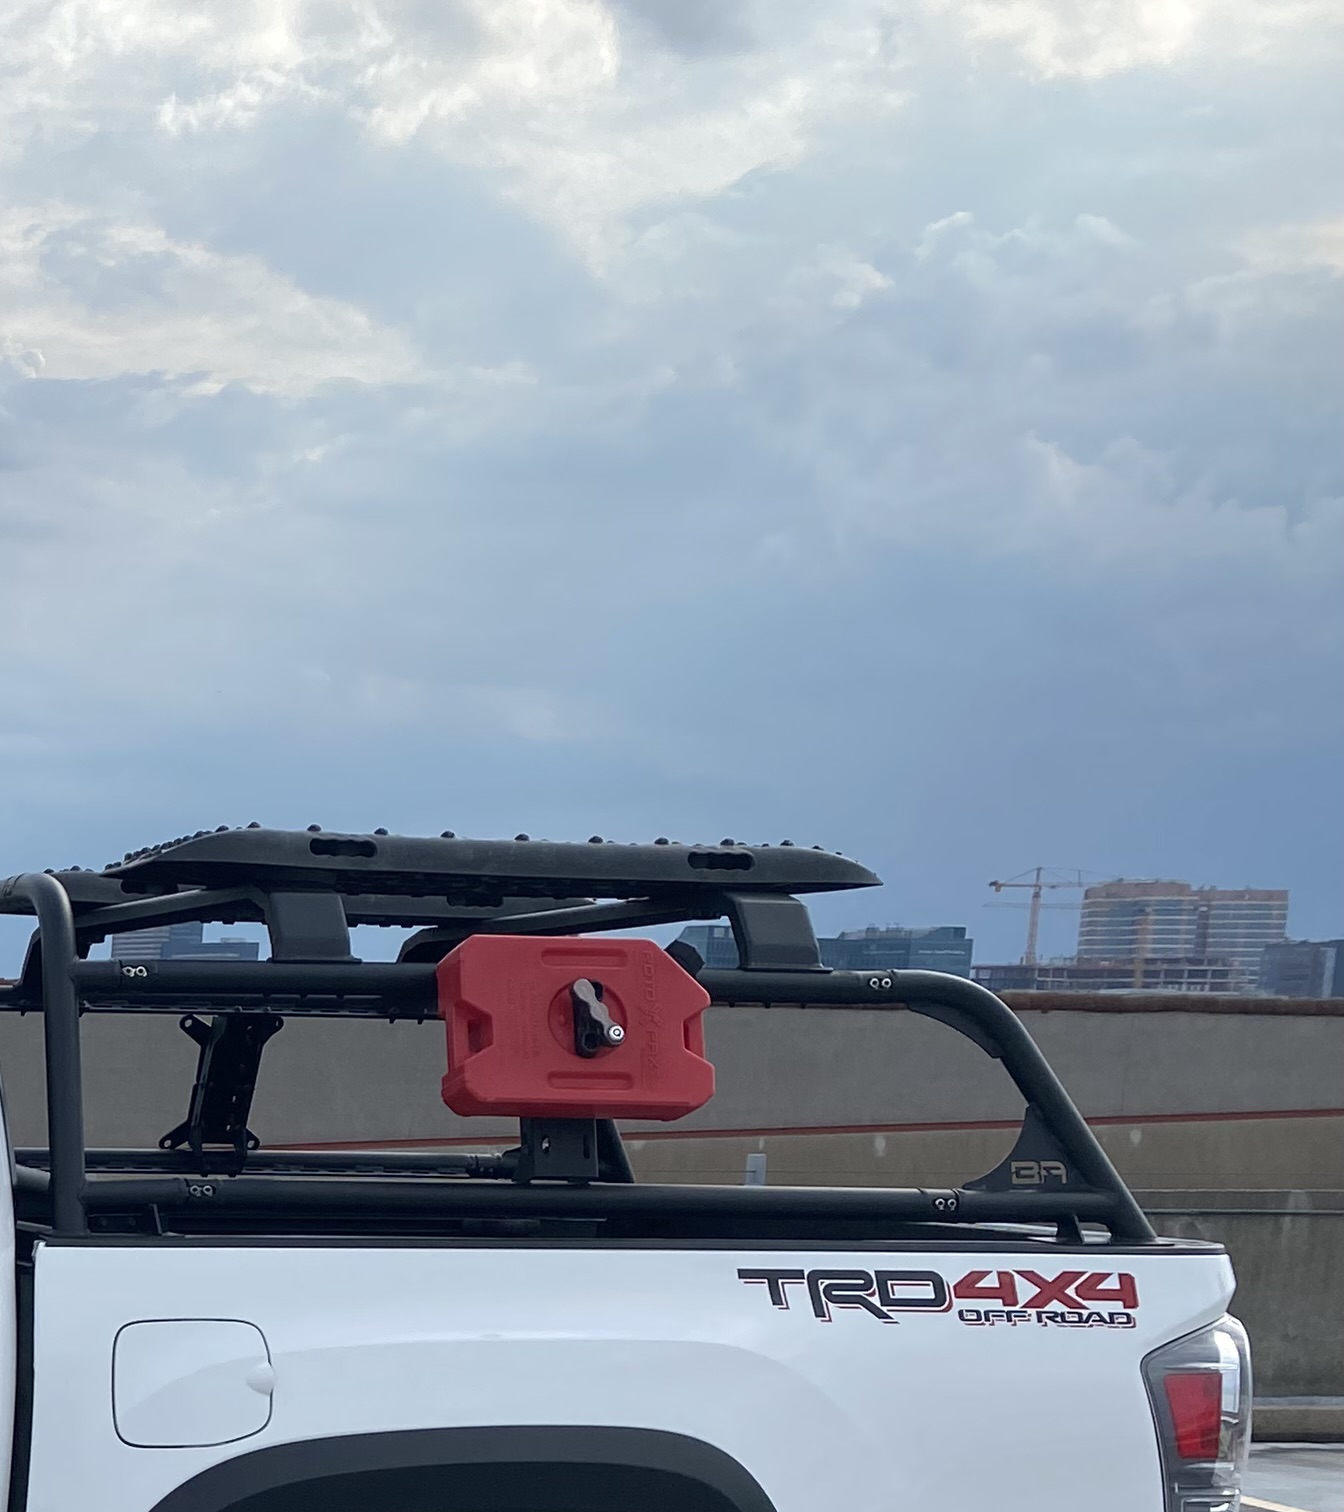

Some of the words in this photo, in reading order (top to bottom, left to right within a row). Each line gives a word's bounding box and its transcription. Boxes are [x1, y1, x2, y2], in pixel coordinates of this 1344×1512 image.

[737, 1268, 953, 1324] TRD
[958, 1309, 1029, 1327] OFF
[1035, 1310, 1137, 1329] ROAD
